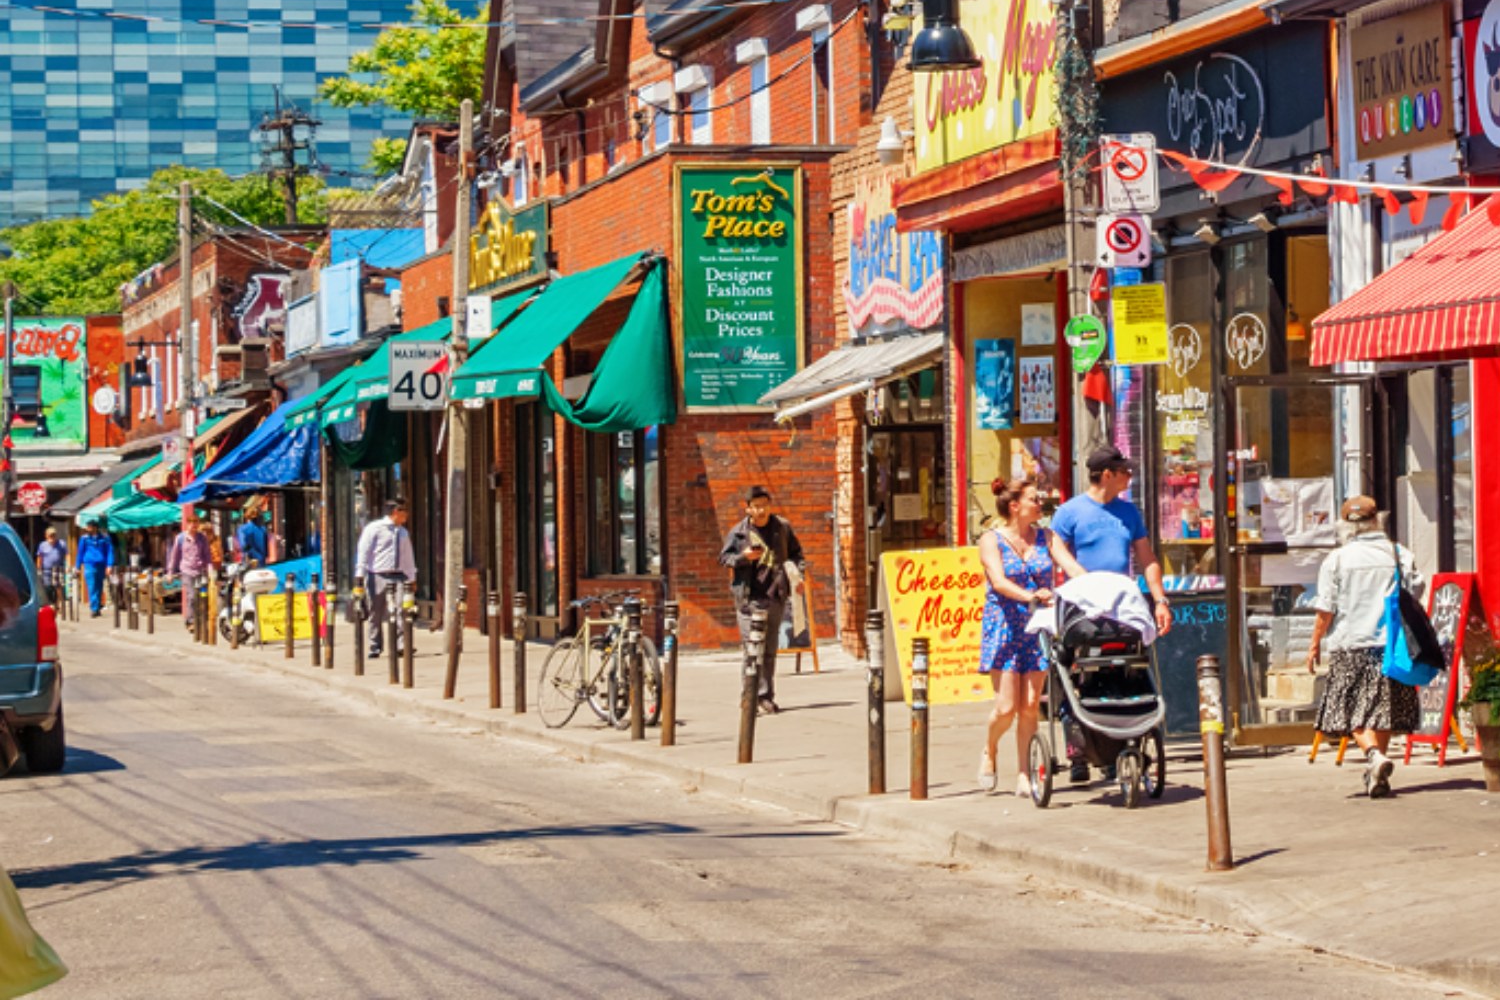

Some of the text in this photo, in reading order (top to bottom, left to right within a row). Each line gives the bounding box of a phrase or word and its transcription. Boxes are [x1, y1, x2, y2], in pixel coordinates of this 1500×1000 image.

[1355, 56, 1378, 103] THE
[1409, 37, 1441, 87] CARE
[1360, 89, 1441, 144] QUEENS
[690, 187, 774, 214] Tom's
[703, 215, 786, 239] Place
[705, 266, 773, 286] Designer
[706, 282, 773, 297] Fashions
[705, 307, 774, 323] Discount
[717, 323, 764, 338] Prices
[394, 350, 442, 360] MAXIMUM
[392, 370, 443, 401] 40
[896, 559, 983, 595] Cheese
[916, 594, 985, 639] Magic
[1197, 601, 1227, 626] SPO
